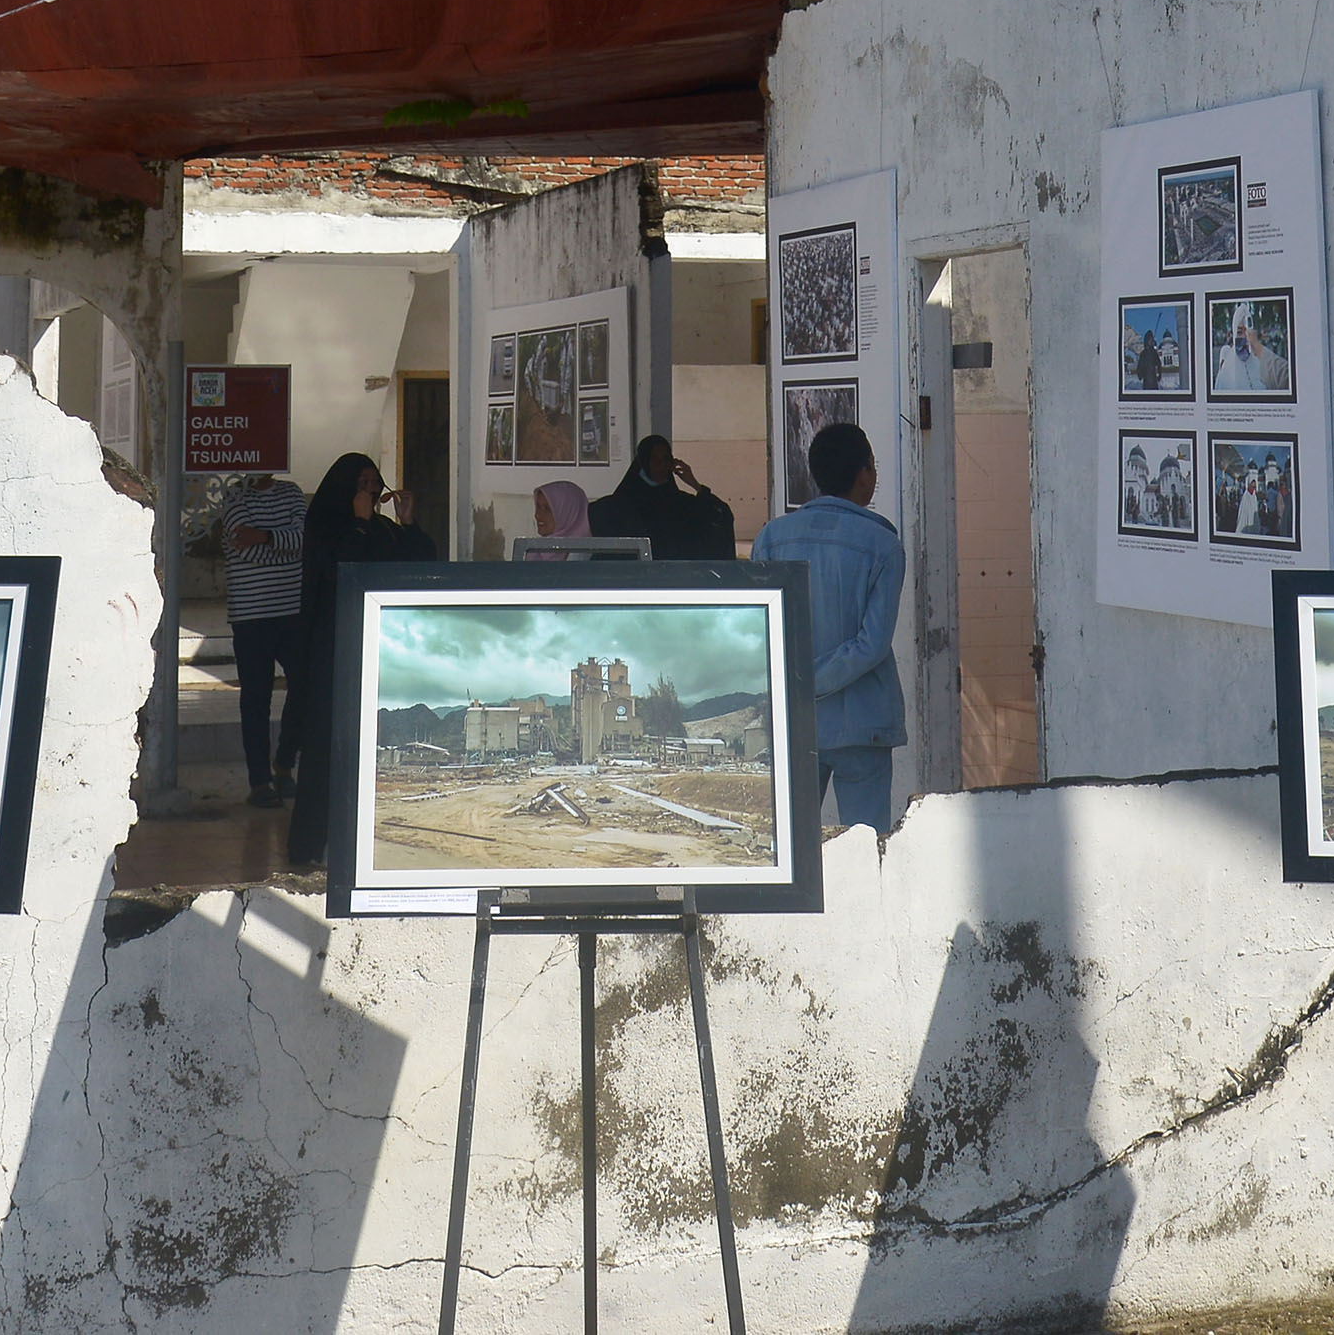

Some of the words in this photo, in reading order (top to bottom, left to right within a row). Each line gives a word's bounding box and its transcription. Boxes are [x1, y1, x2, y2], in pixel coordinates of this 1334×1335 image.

[1247, 187, 1267, 200] FOTO
[191, 416, 249, 429] GALERI
[191, 434, 233, 446] FOTO
[191, 450, 260, 463] TSUNAMI
